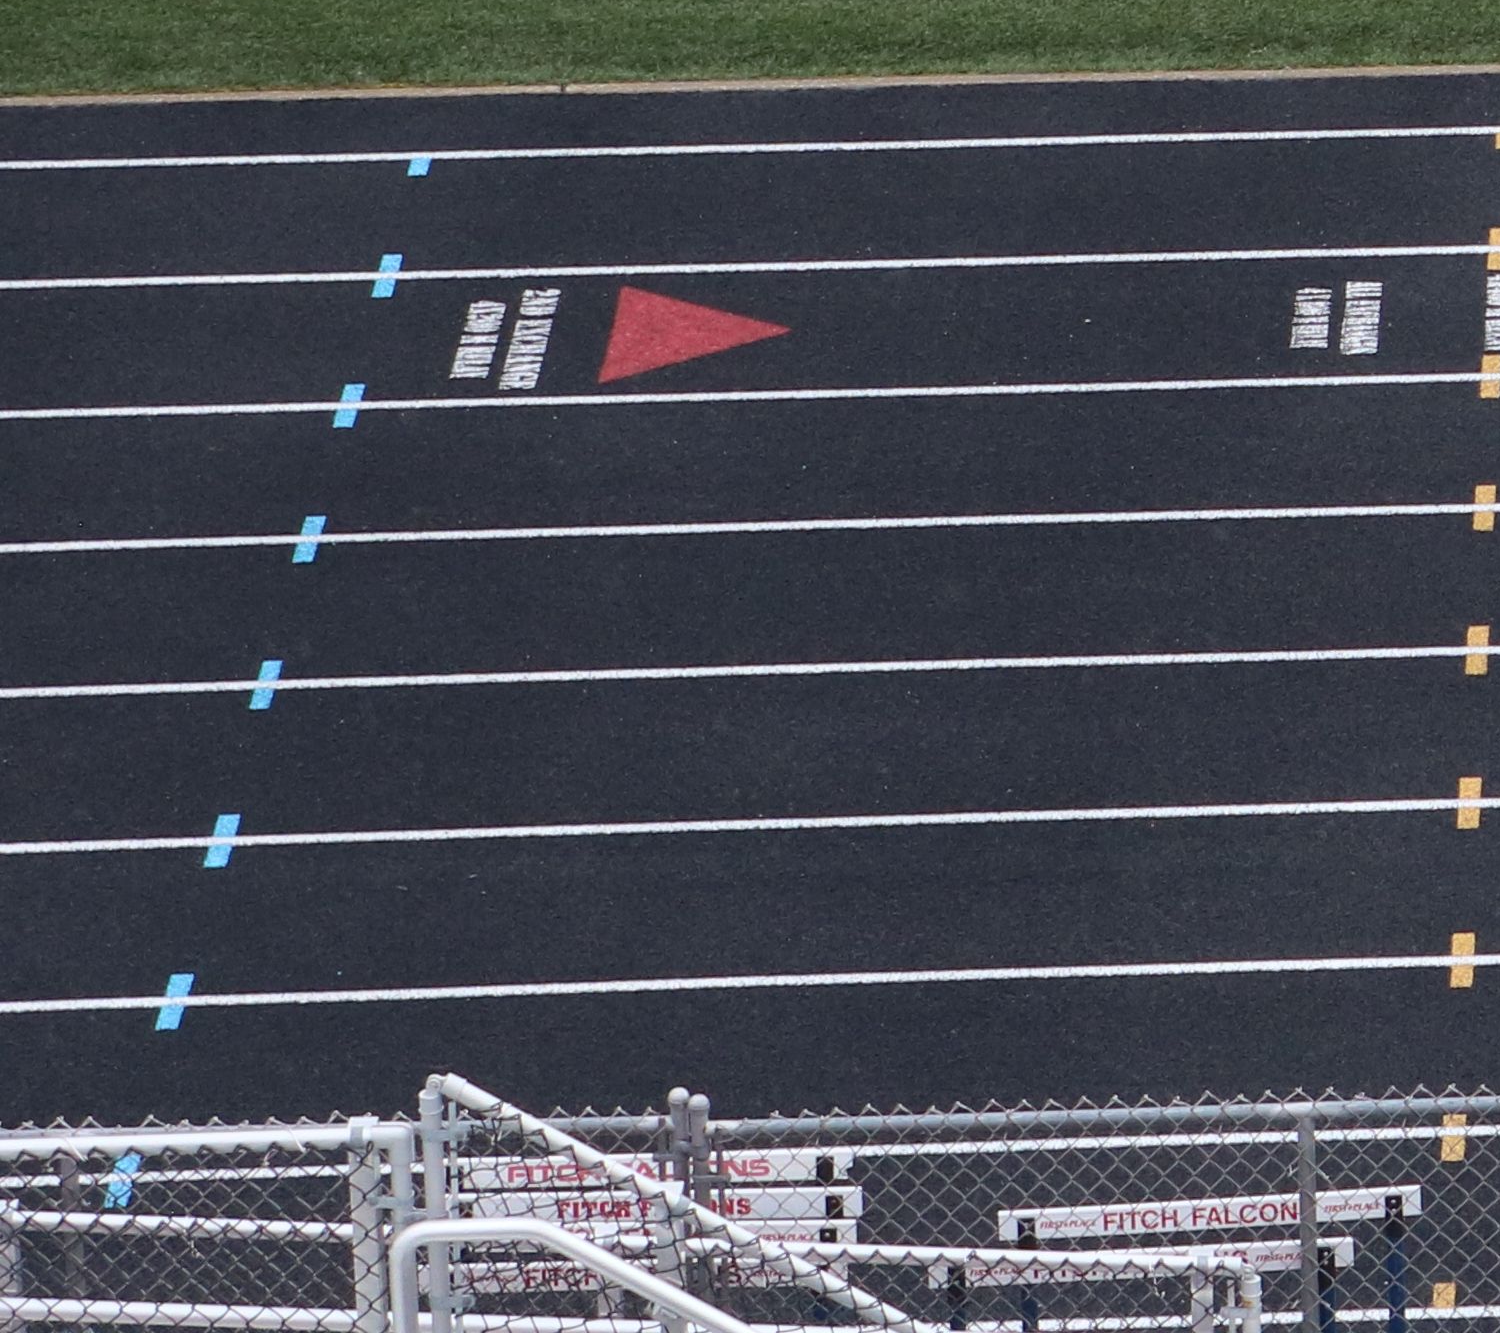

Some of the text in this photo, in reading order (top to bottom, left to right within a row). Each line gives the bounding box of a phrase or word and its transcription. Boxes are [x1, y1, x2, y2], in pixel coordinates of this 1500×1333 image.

[499, 288, 561, 390] 2ND EXCHANGE
[557, 1199, 631, 1220] FITCH
[1103, 1208, 1178, 1232] FITCH
[1192, 1202, 1298, 1227] FALCON
